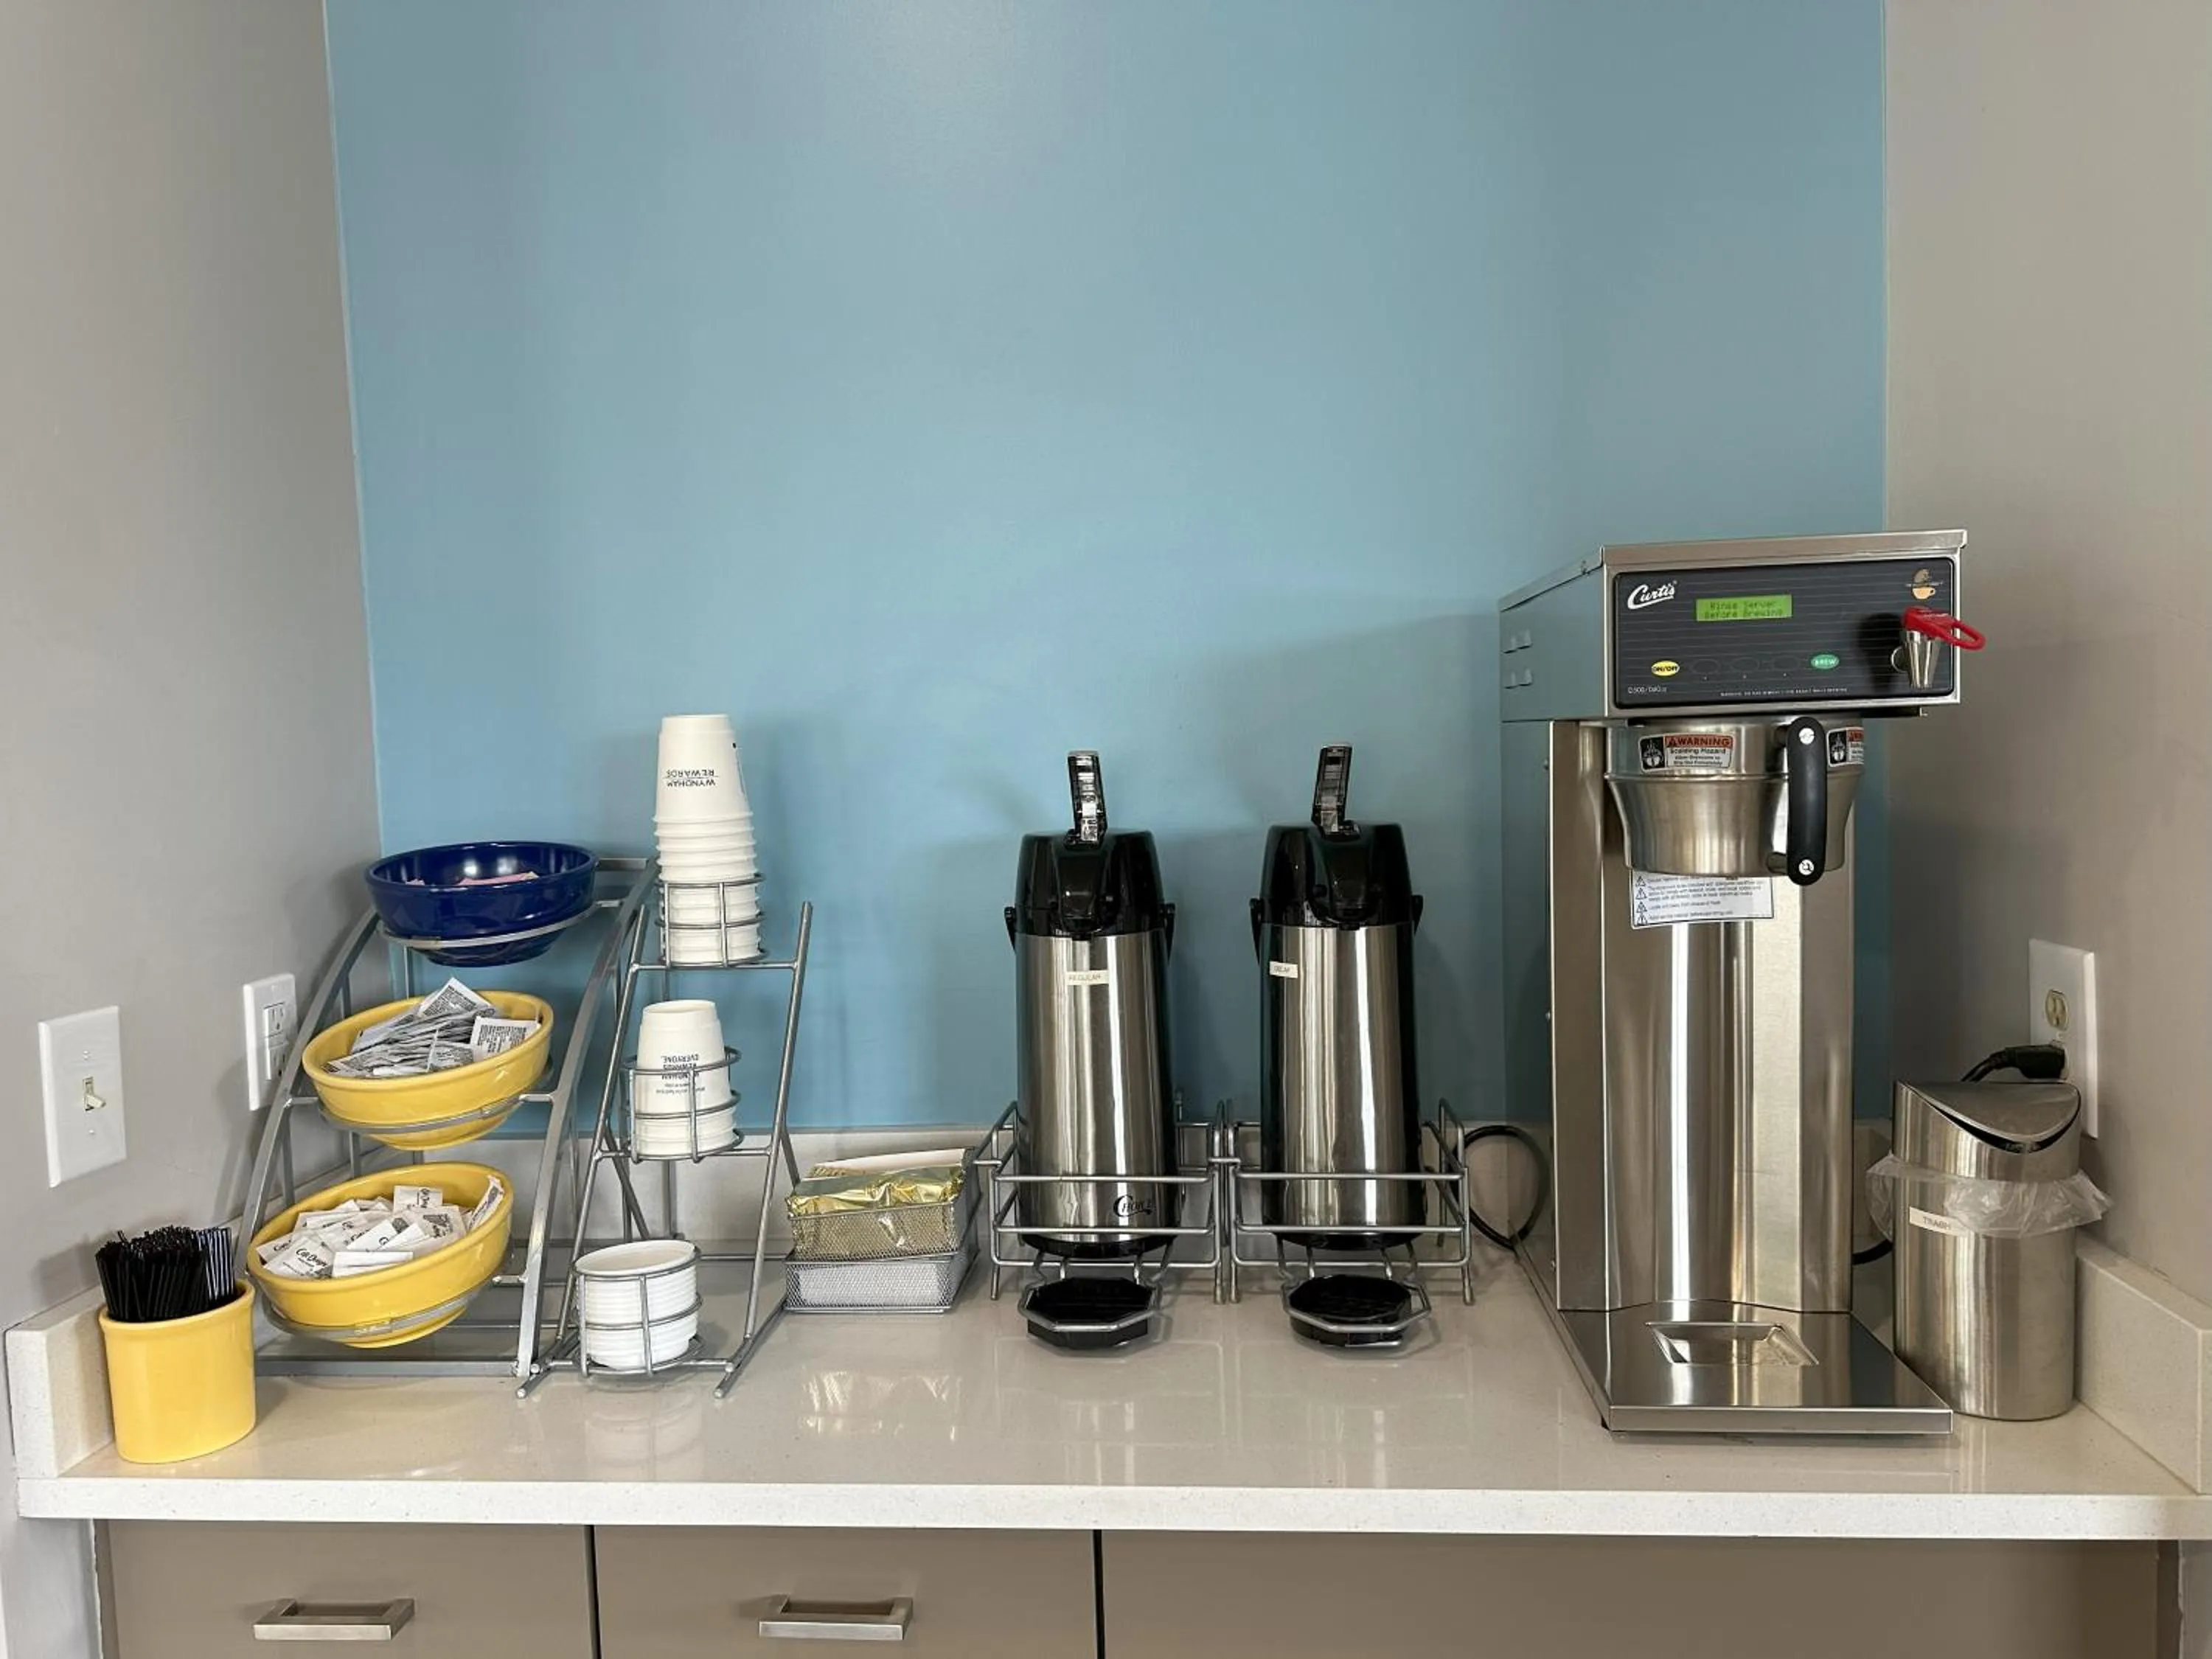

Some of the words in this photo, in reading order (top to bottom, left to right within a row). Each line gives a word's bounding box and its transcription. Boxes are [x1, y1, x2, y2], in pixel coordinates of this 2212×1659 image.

[1627, 582, 1674, 610] Curtis
[1677, 737, 1730, 746] WARNING
[666, 769, 714, 778] REWARDS
[667, 779, 716, 787] WYNDHAM
